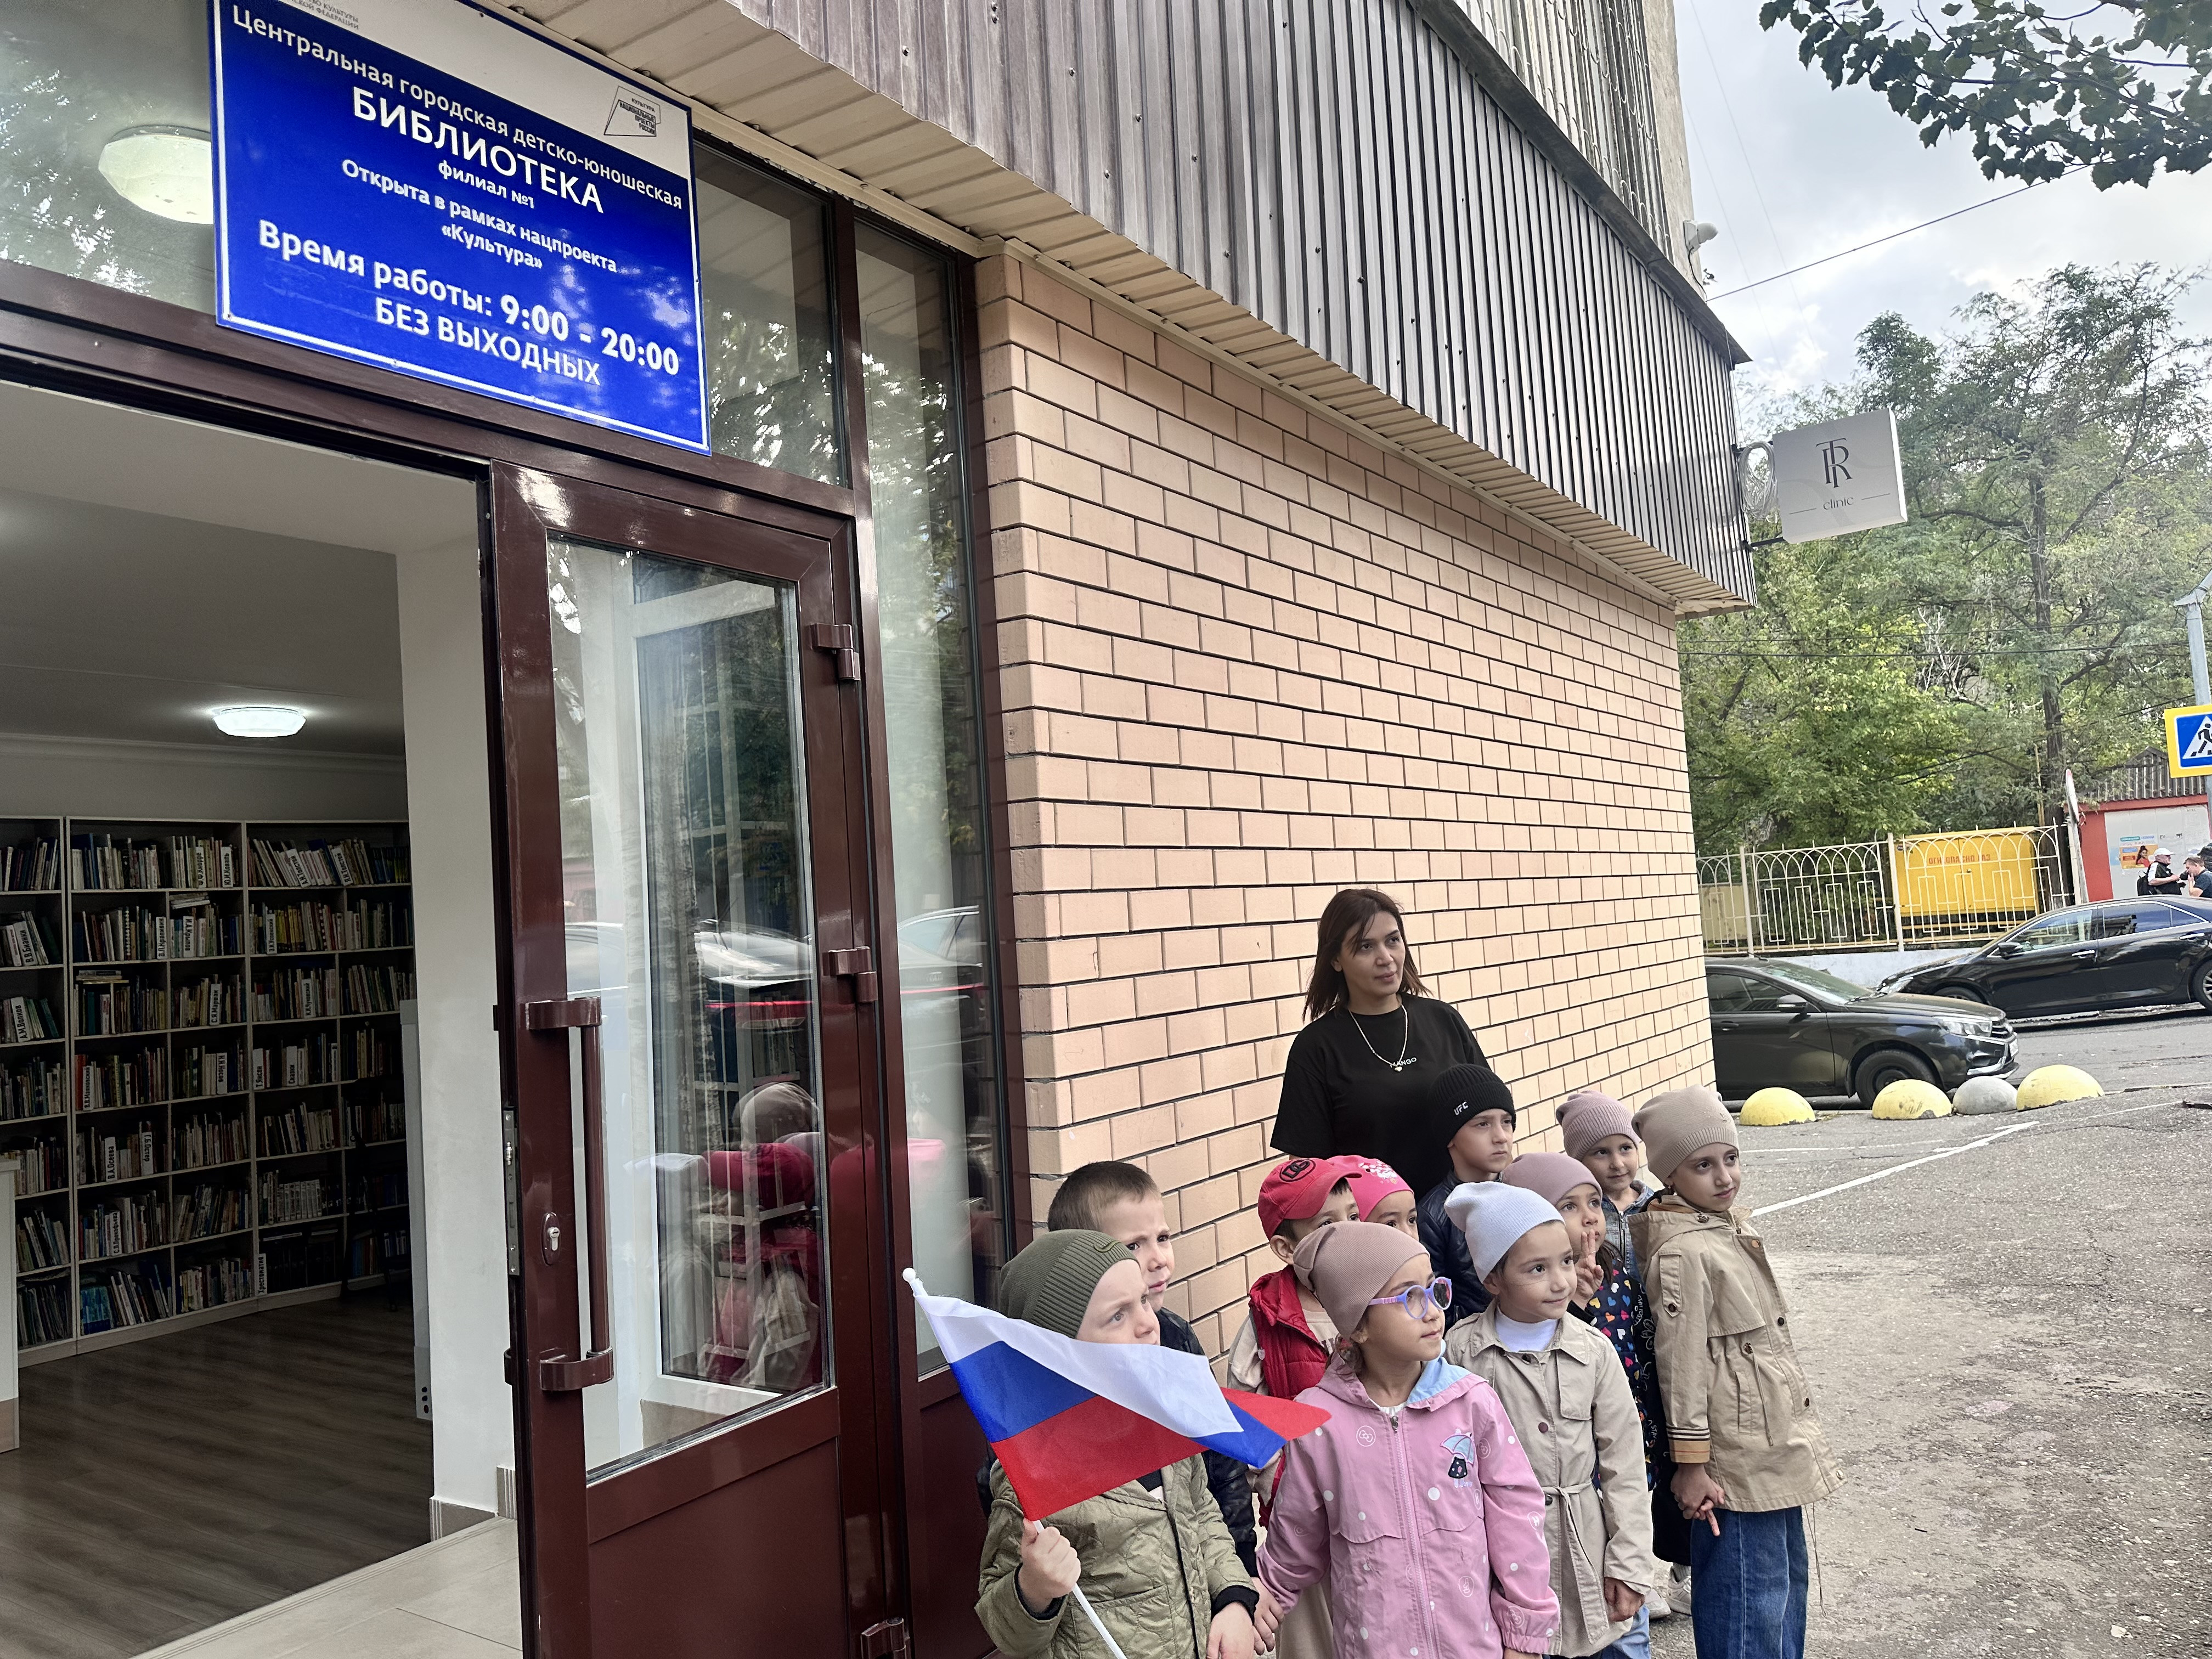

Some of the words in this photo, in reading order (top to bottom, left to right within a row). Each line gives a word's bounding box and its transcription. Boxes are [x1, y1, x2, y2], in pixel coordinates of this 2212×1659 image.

[315, 7, 359, 30] ФЕДЕРАЦИИ
[324, 3, 359, 24] КУЛЬТУРЫ
[234, 5, 393, 88] Центральная
[400, 79, 508, 137] городская
[513, 128, 682, 210] детско-юношеская
[631, 98, 656, 113] КУЛЬТУРА
[353, 86, 603, 213] БИБЛИОТЕКА
[438, 160, 507, 199] филиал
[342, 159, 430, 205] Открыта
[435, 195, 445, 210] в
[450, 201, 517, 236] рамках
[520, 227, 617, 273] нацпроекта
[442, 223, 543, 268] «Культура»
[259, 219, 365, 276] Время
[374, 261, 492, 317] работы:
[500, 295, 569, 342] 9:00
[601, 328, 679, 375] 20:00
[376, 297, 430, 336] БЕЗ
[438, 315, 601, 386] ВЫХОДНЫХ
[1822, 496, 1854, 510] clinic
[19, 929, 34, 963] В.В.Бианки
[183, 918, 193, 951] И.А.Крылов
[15, 1005, 28, 1039] А.М.Волков
[211, 990, 219, 1023] С.Я.Маршак
[1454, 1101, 1469, 1116] UFC
[107, 1146, 115, 1180] В.А.Осеева
[143, 1134, 151, 1162] Г.Б.Остер
[257, 1256, 266, 1293] Хрестоматия
